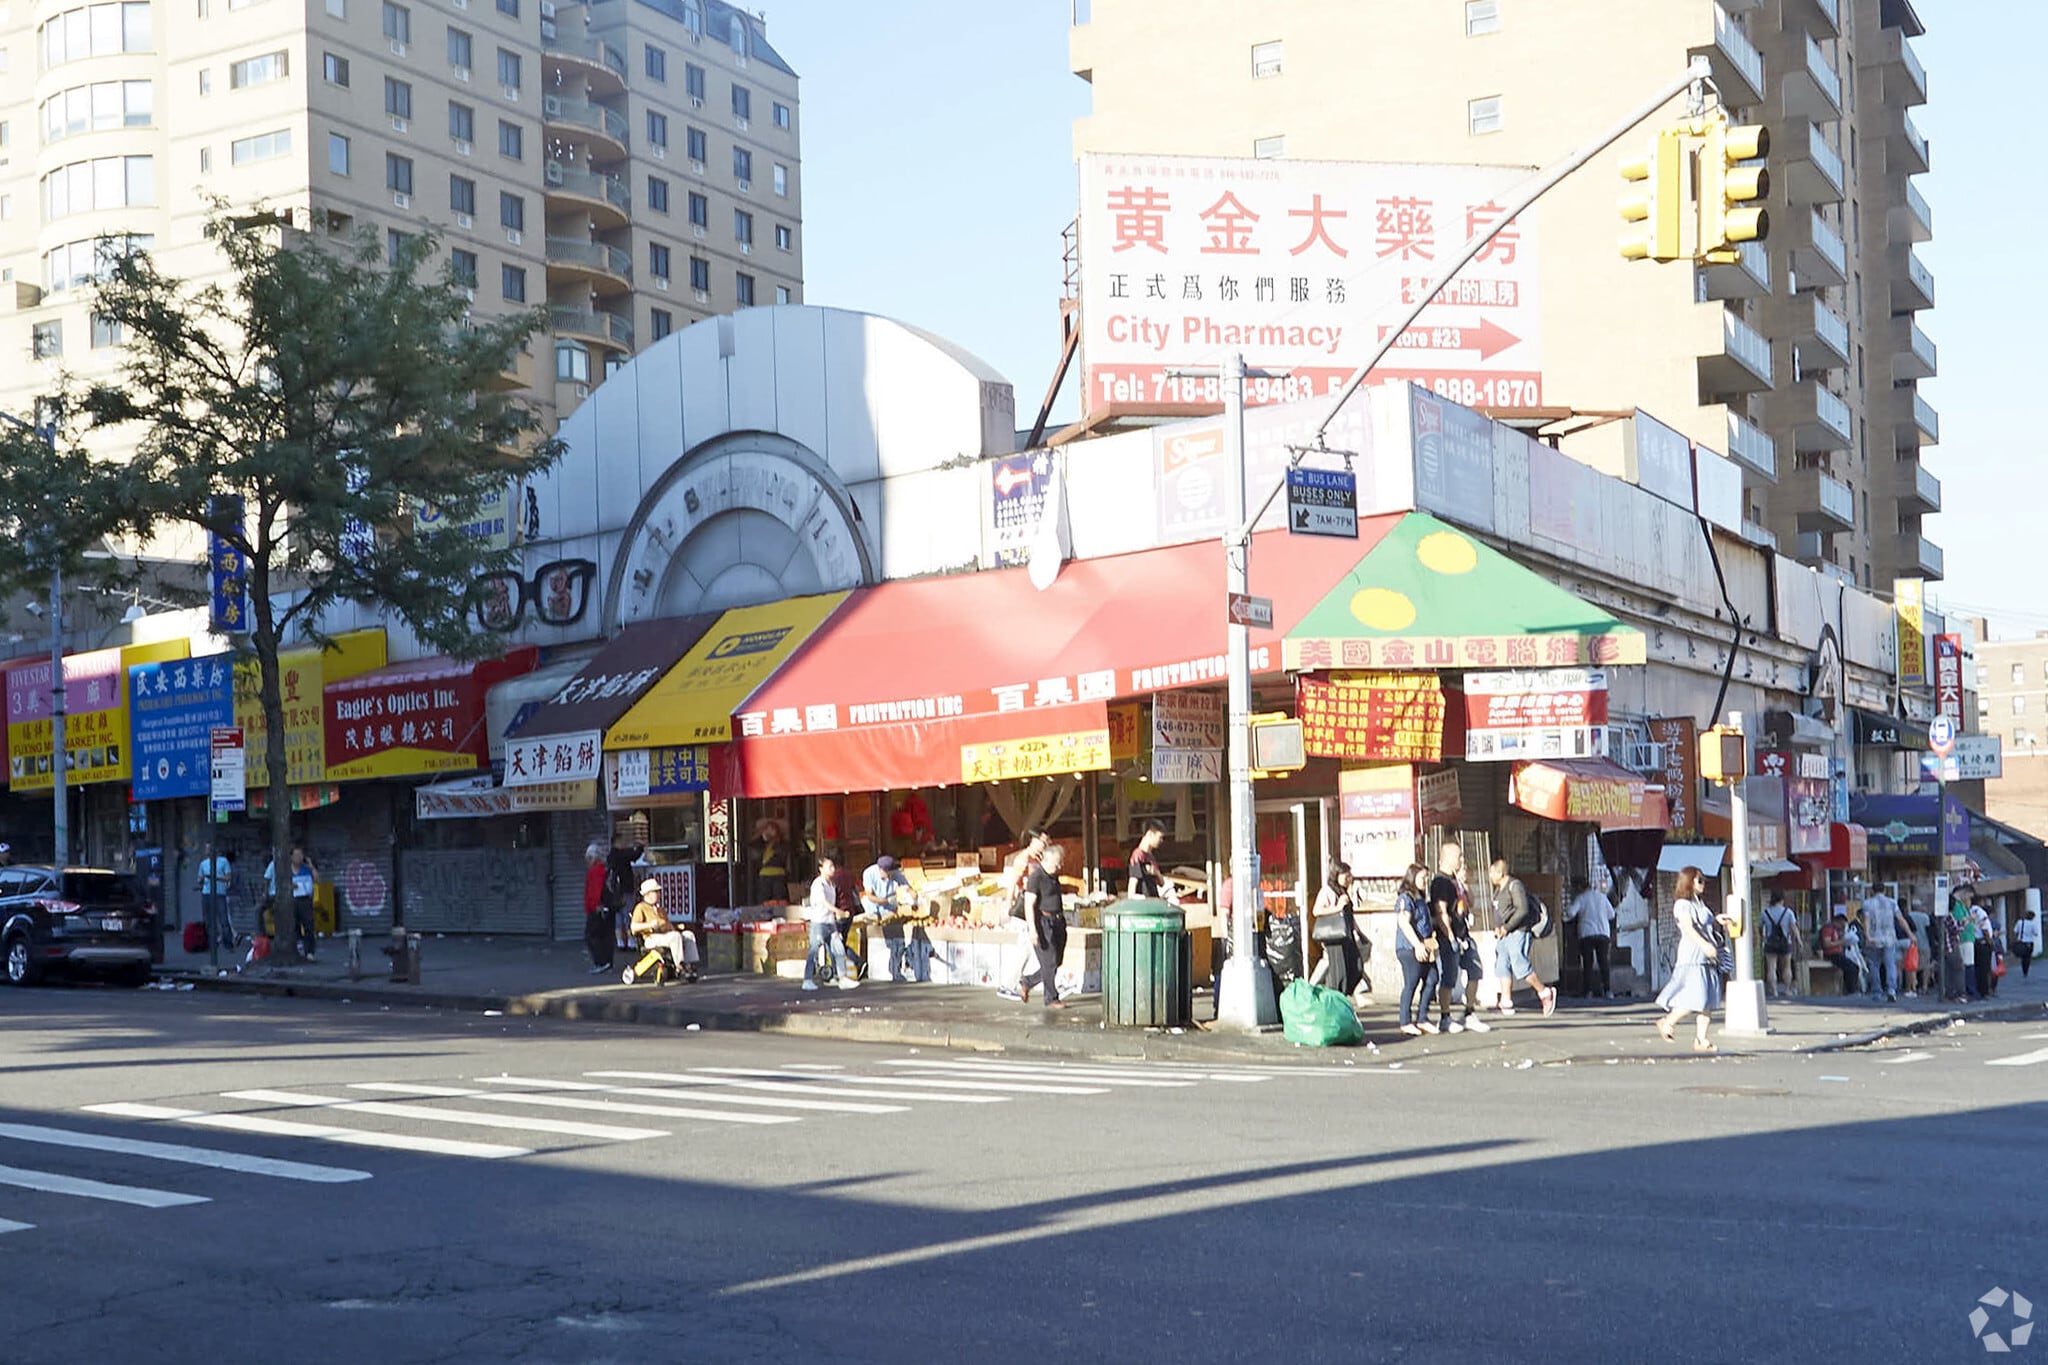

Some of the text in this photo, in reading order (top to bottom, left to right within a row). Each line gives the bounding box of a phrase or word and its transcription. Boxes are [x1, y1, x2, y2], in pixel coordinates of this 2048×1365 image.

[1106, 314, 1342, 354] City Pharmacy
[1388, 328, 1462, 348] tore #23
[1098, 372, 1145, 402] Tel:
[1307, 473, 1350, 488] BUS LANE
[1293, 486, 1352, 502] BUSES ONLY
[1316, 514, 1353, 528] 7AM-7PM
[1253, 607, 1270, 622] WAY
[29, 667, 50, 684] STAR
[336, 688, 460, 720] Eagle's Optics Inc.
[937, 694, 964, 716] INC
